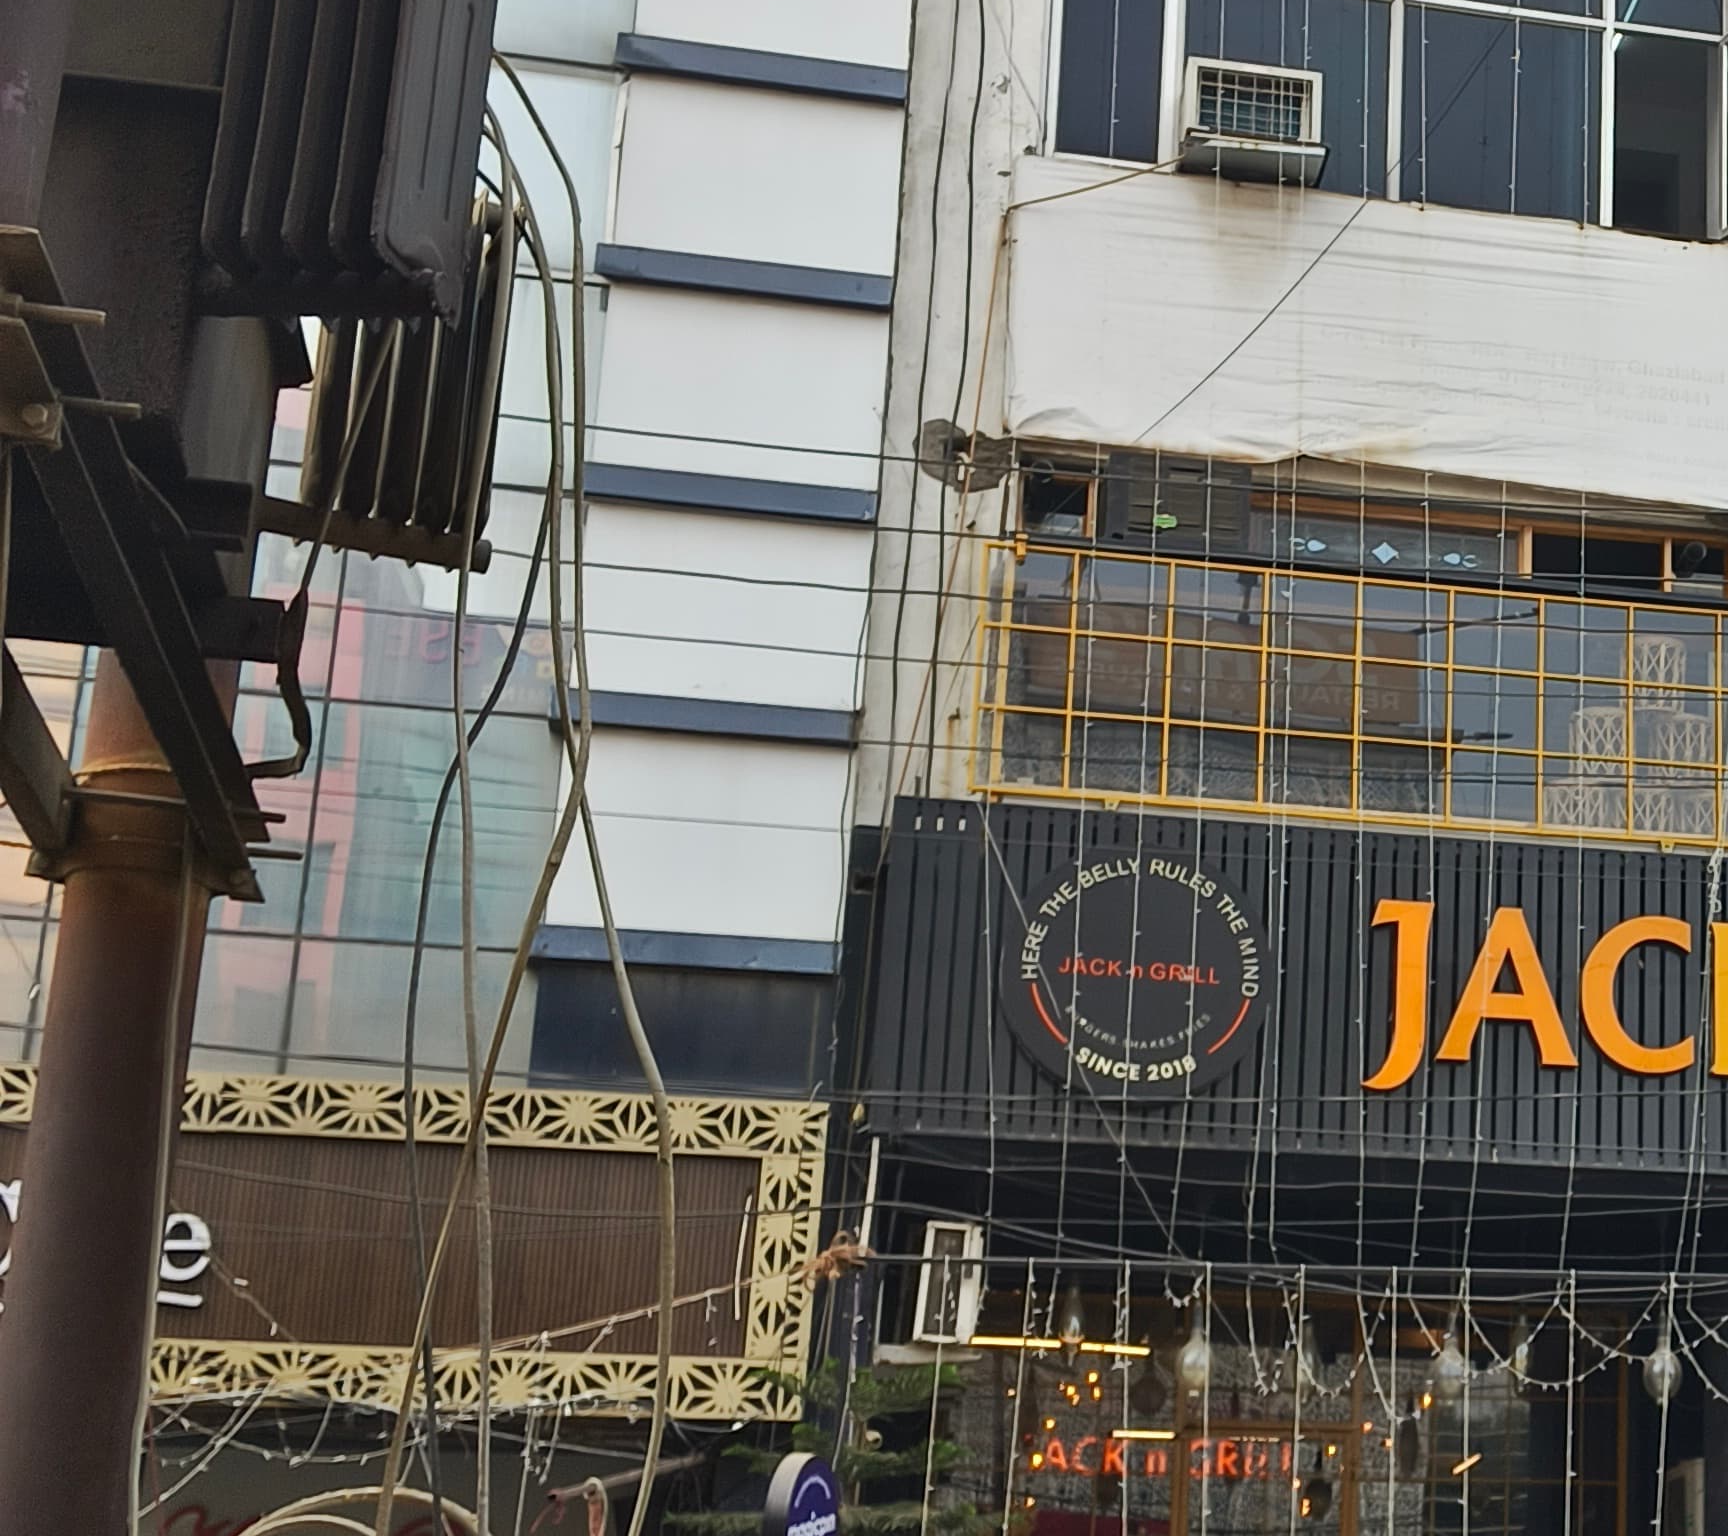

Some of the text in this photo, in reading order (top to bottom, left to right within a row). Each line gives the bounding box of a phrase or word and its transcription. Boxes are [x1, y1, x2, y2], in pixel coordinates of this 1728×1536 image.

[1020, 857, 1260, 998] HERE THE BELLY RULES THE MIND
[1058, 956, 1123, 977] JACK
[1150, 962, 1220, 985] GRILL
[1075, 1046, 1141, 1081] SINCE
